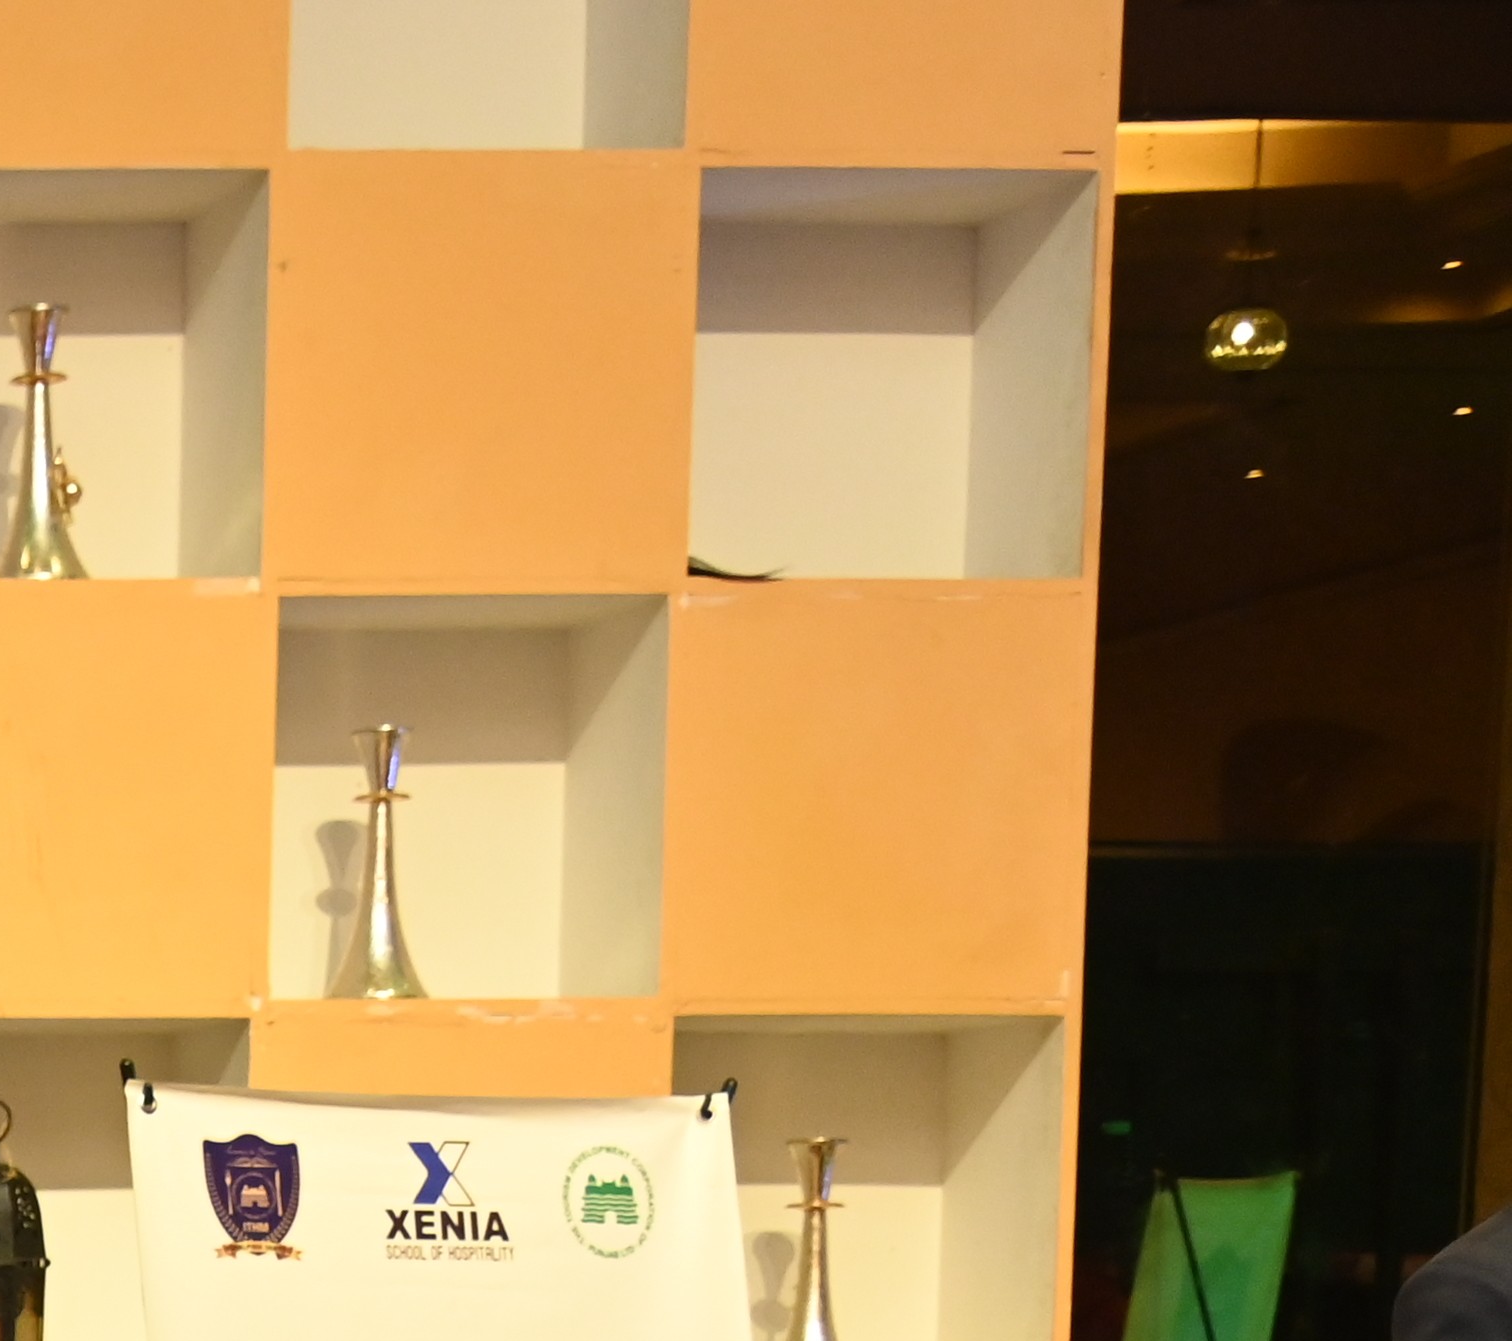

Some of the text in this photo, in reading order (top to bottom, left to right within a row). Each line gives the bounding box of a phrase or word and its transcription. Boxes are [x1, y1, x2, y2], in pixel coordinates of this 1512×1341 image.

[386, 1210, 509, 1241] XENIA
[386, 1245, 514, 1261] SCHOOL OF HOSPITALITY
